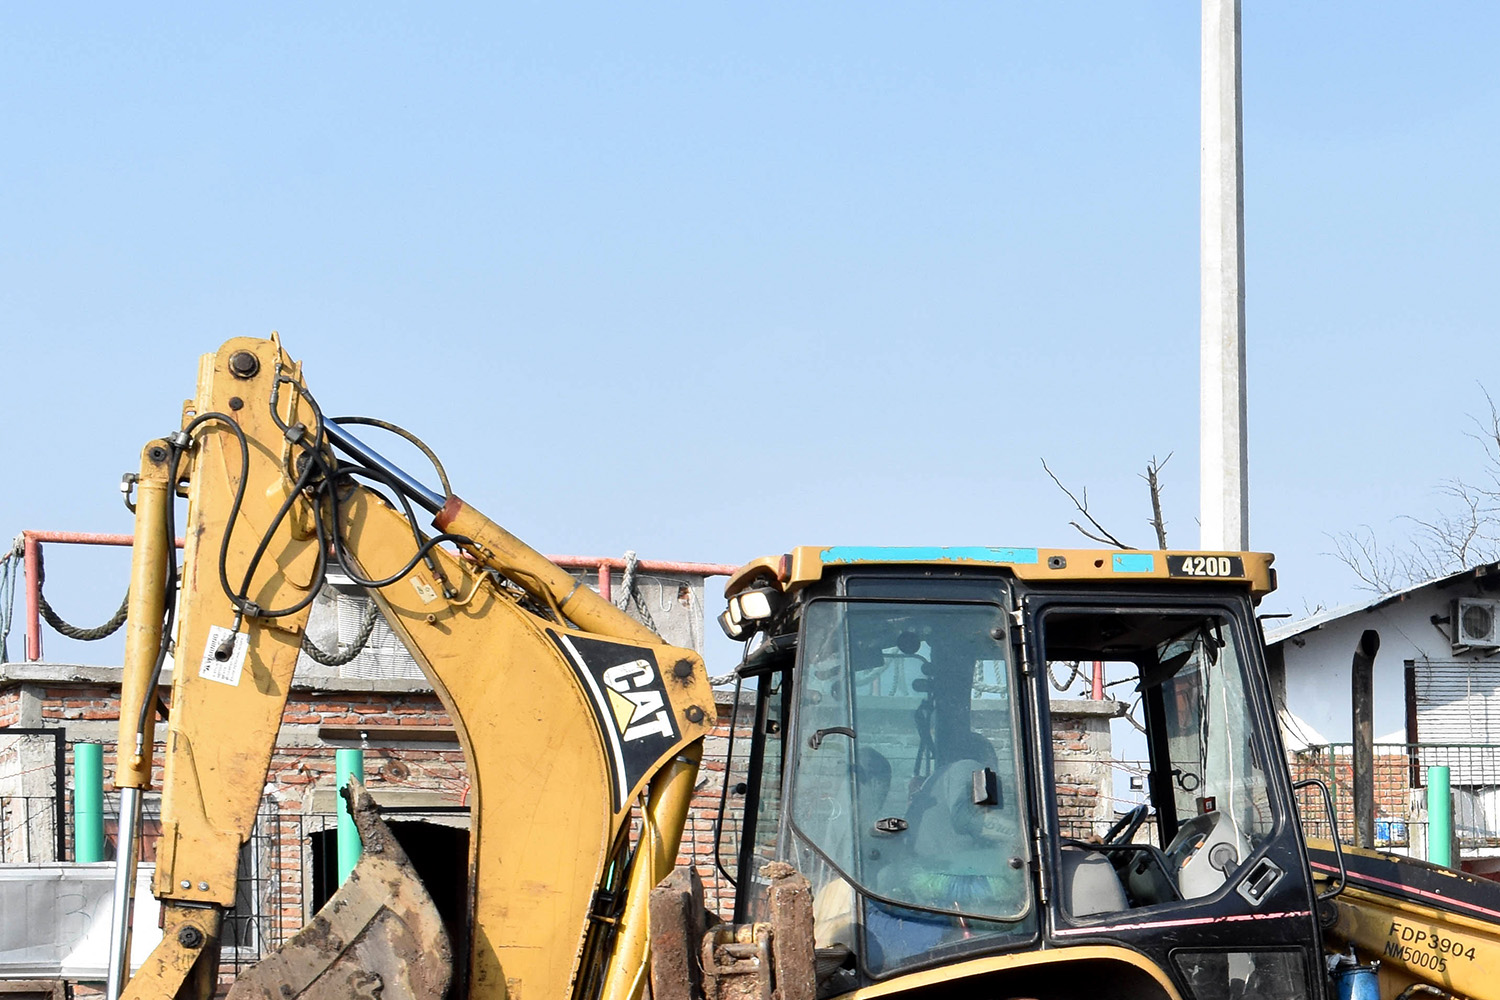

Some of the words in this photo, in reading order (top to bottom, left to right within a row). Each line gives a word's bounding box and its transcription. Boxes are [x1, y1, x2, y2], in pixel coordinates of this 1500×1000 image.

[1181, 556, 1231, 577] 420D
[602, 659, 675, 742] CAT
[1383, 940, 1448, 973] NM50005
